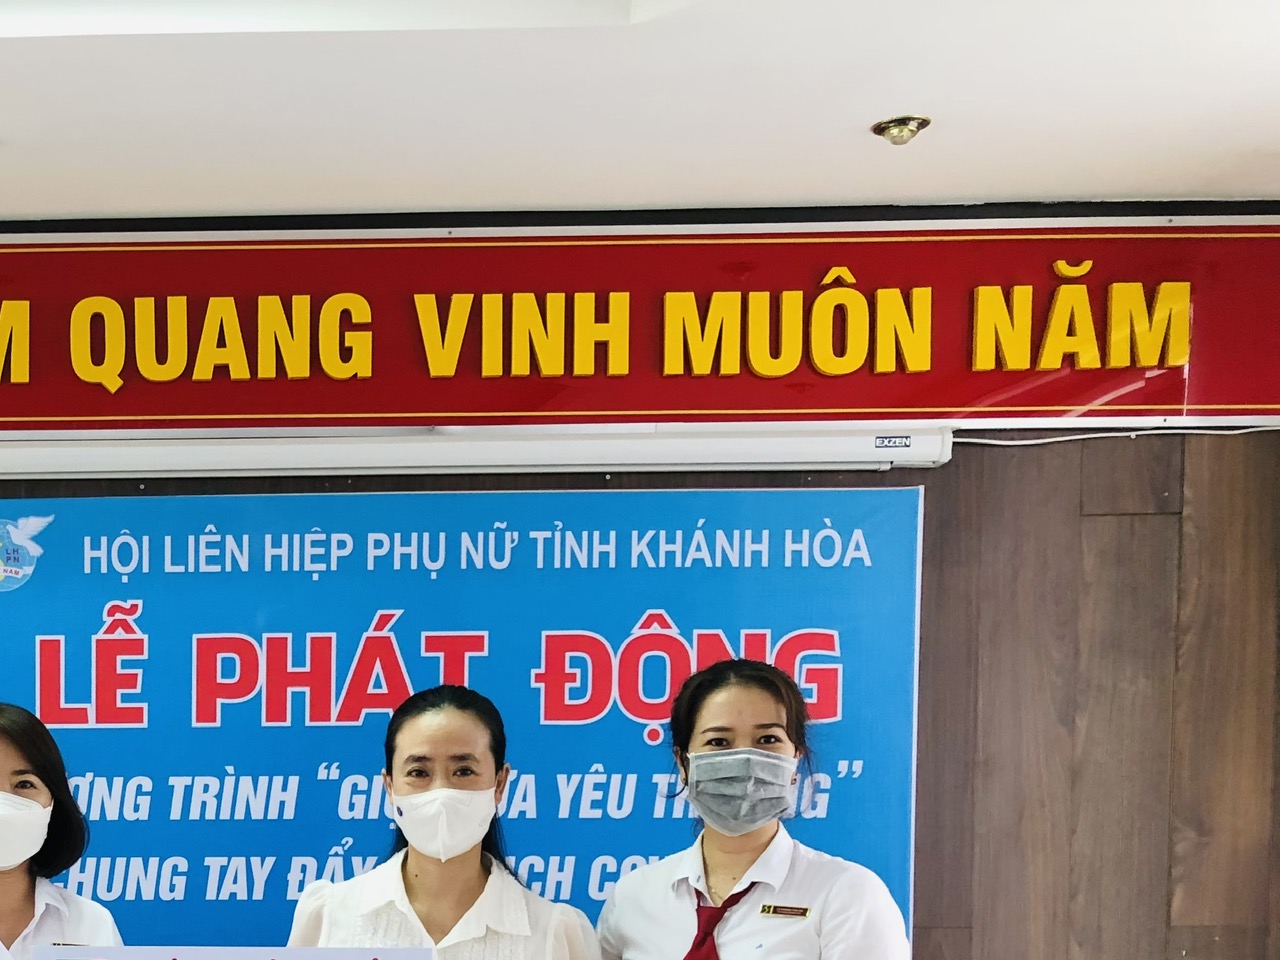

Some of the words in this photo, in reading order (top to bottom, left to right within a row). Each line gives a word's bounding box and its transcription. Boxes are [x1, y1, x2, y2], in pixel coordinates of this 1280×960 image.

[69, 292, 374, 394] QUANG
[414, 291, 630, 378] VINH
[663, 266, 933, 378] MUÔN
[971, 259, 1192, 373] NĂM
[876, 437, 910, 447] EXZEN
[3, 568, 20, 576] NAM
[83, 529, 150, 583] HỘI
[164, 524, 250, 573] LIÊN
[264, 527, 354, 581] HIỆP
[367, 531, 446, 579] PHỤ
[460, 521, 519, 570] NỮ
[529, 520, 616, 569] TỈNH
[631, 518, 770, 568] KHÁNH
[785, 518, 872, 567] HÒA
[35, 599, 149, 728] LỄ
[192, 609, 489, 727] PHÁT
[66, 772, 153, 821] ƠNG
[168, 765, 300, 821] TRÌNH
[556, 763, 638, 820] YÊU
[48, 856, 189, 901] HUNG
[204, 856, 277, 901] TAY
